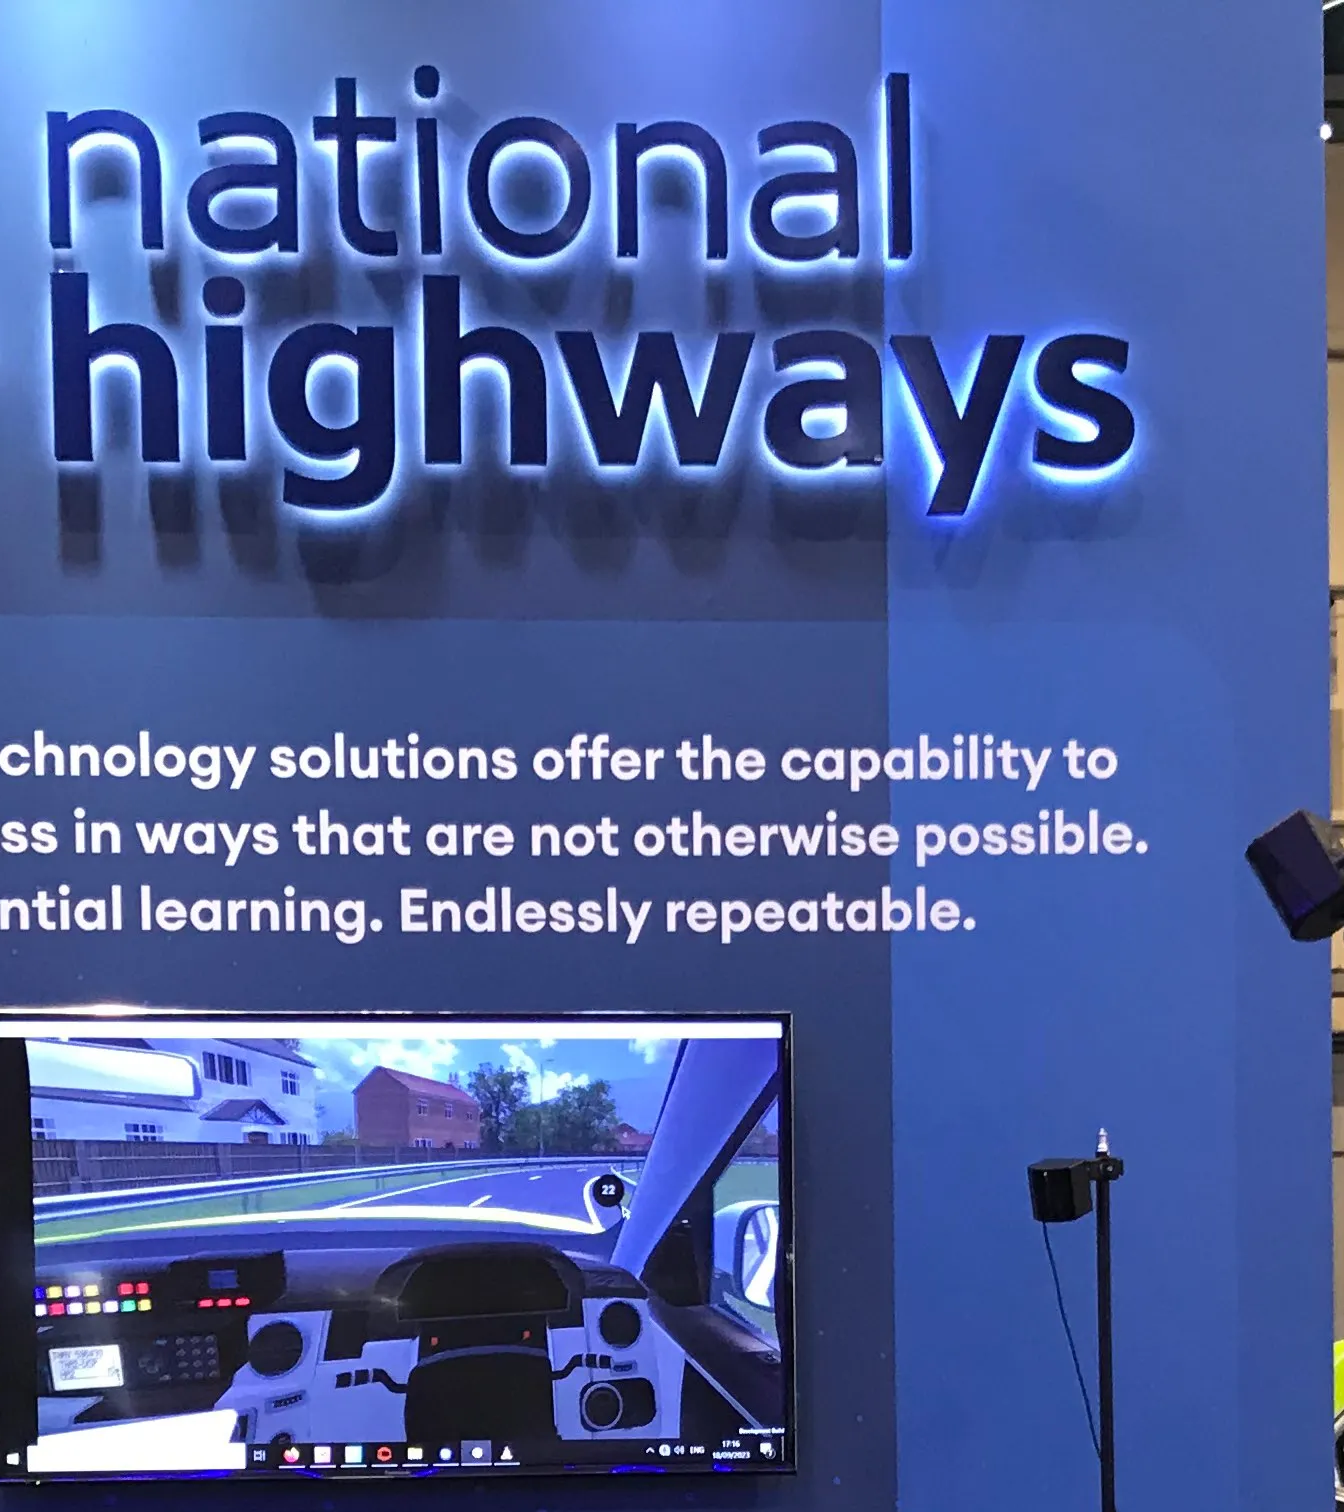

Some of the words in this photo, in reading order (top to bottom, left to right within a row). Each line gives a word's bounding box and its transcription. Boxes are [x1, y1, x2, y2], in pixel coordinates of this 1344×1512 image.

[45, 64, 913, 261] national
[49, 270, 1137, 517] highways
[270, 732, 518, 780] solutions
[533, 734, 664, 780] offer
[675, 734, 766, 780] the
[781, 734, 1052, 792] capability
[1063, 741, 1118, 780] to
[74, 807, 121, 854] in
[135, 822, 279, 867] ways
[292, 809, 411, 856] that
[426, 824, 514, 857] are
[531, 817, 619, 857] not
[634, 810, 899, 857] otherwise
[916, 809, 1148, 868] possible.
[140, 885, 383, 944] learning.
[400, 886, 652, 944] Endlessly
[666, 886, 976, 944] repeatable.
[601, 1184, 616, 1195] 22
